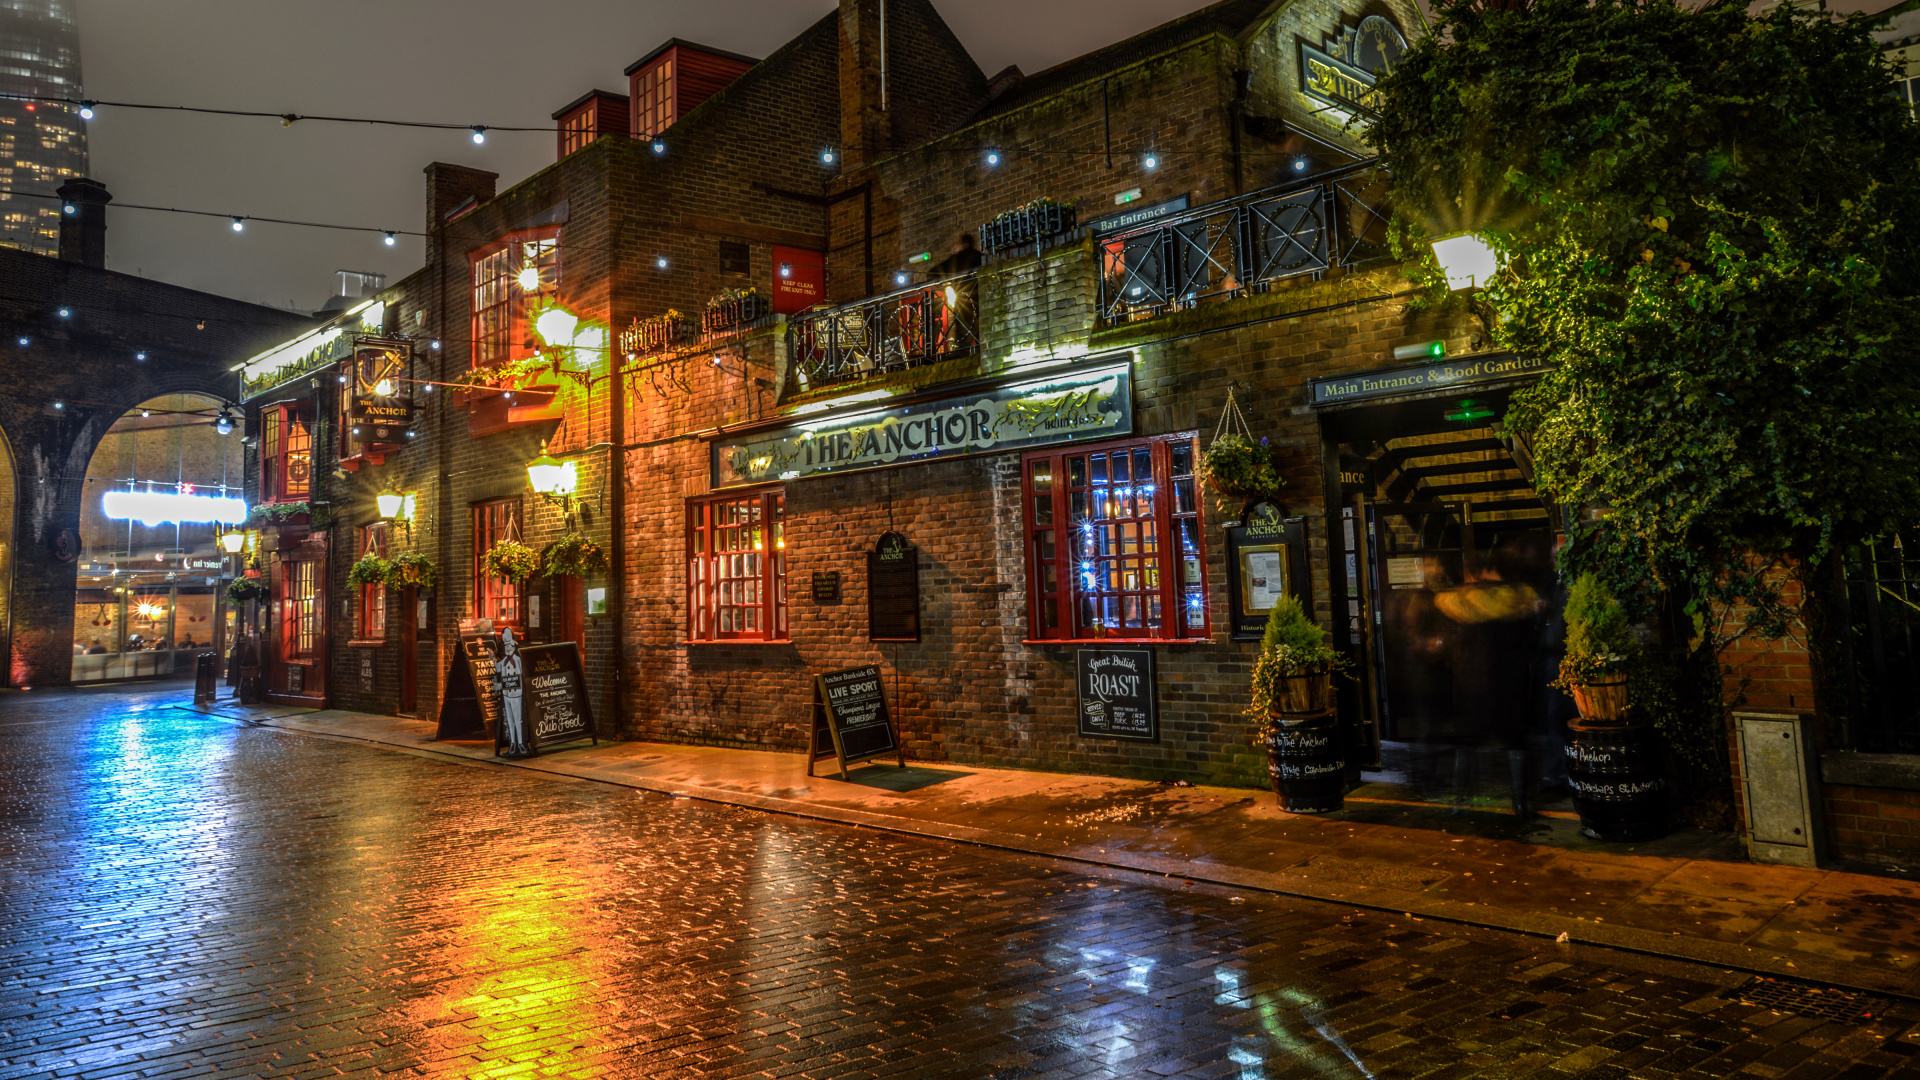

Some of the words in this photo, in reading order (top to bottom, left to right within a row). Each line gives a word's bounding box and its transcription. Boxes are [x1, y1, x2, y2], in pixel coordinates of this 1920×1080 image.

[1101, 220, 1118, 231] Bar
[1120, 207, 1166, 226] Entrance
[1324, 382, 1359, 397] Main
[1362, 374, 1424, 392] Entrance
[1427, 370, 1440, 382] &
[1443, 363, 1481, 381] Roof
[1483, 357, 1542, 374] Garden
[365, 407, 407, 416] ANCHOR
[800, 430, 852, 466] THE
[861, 408, 992, 457] ANCHOR
[1339, 471, 1365, 484] ance
[1252, 519, 1268, 527] THE
[1246, 524, 1285, 536] ANCHOR
[475, 659, 494, 669] TAKE
[534, 663, 560, 672] ANCHOR
[1088, 656, 1111, 673] Great
[1112, 654, 1138, 673] British
[531, 674, 568, 689] Welcome
[824, 676, 843, 684] Anchor
[843, 670, 866, 680] Bankside
[550, 689, 567, 697] ANCHOR
[829, 686, 848, 699] LIVE
[850, 680, 878, 695] SPORT
[1088, 673, 1140, 702] ROAST
[837, 704, 865, 716] Champions
[557, 714, 585, 731] Food
[1282, 736, 1295, 747] The
[1299, 736, 1328, 747] Anchor
